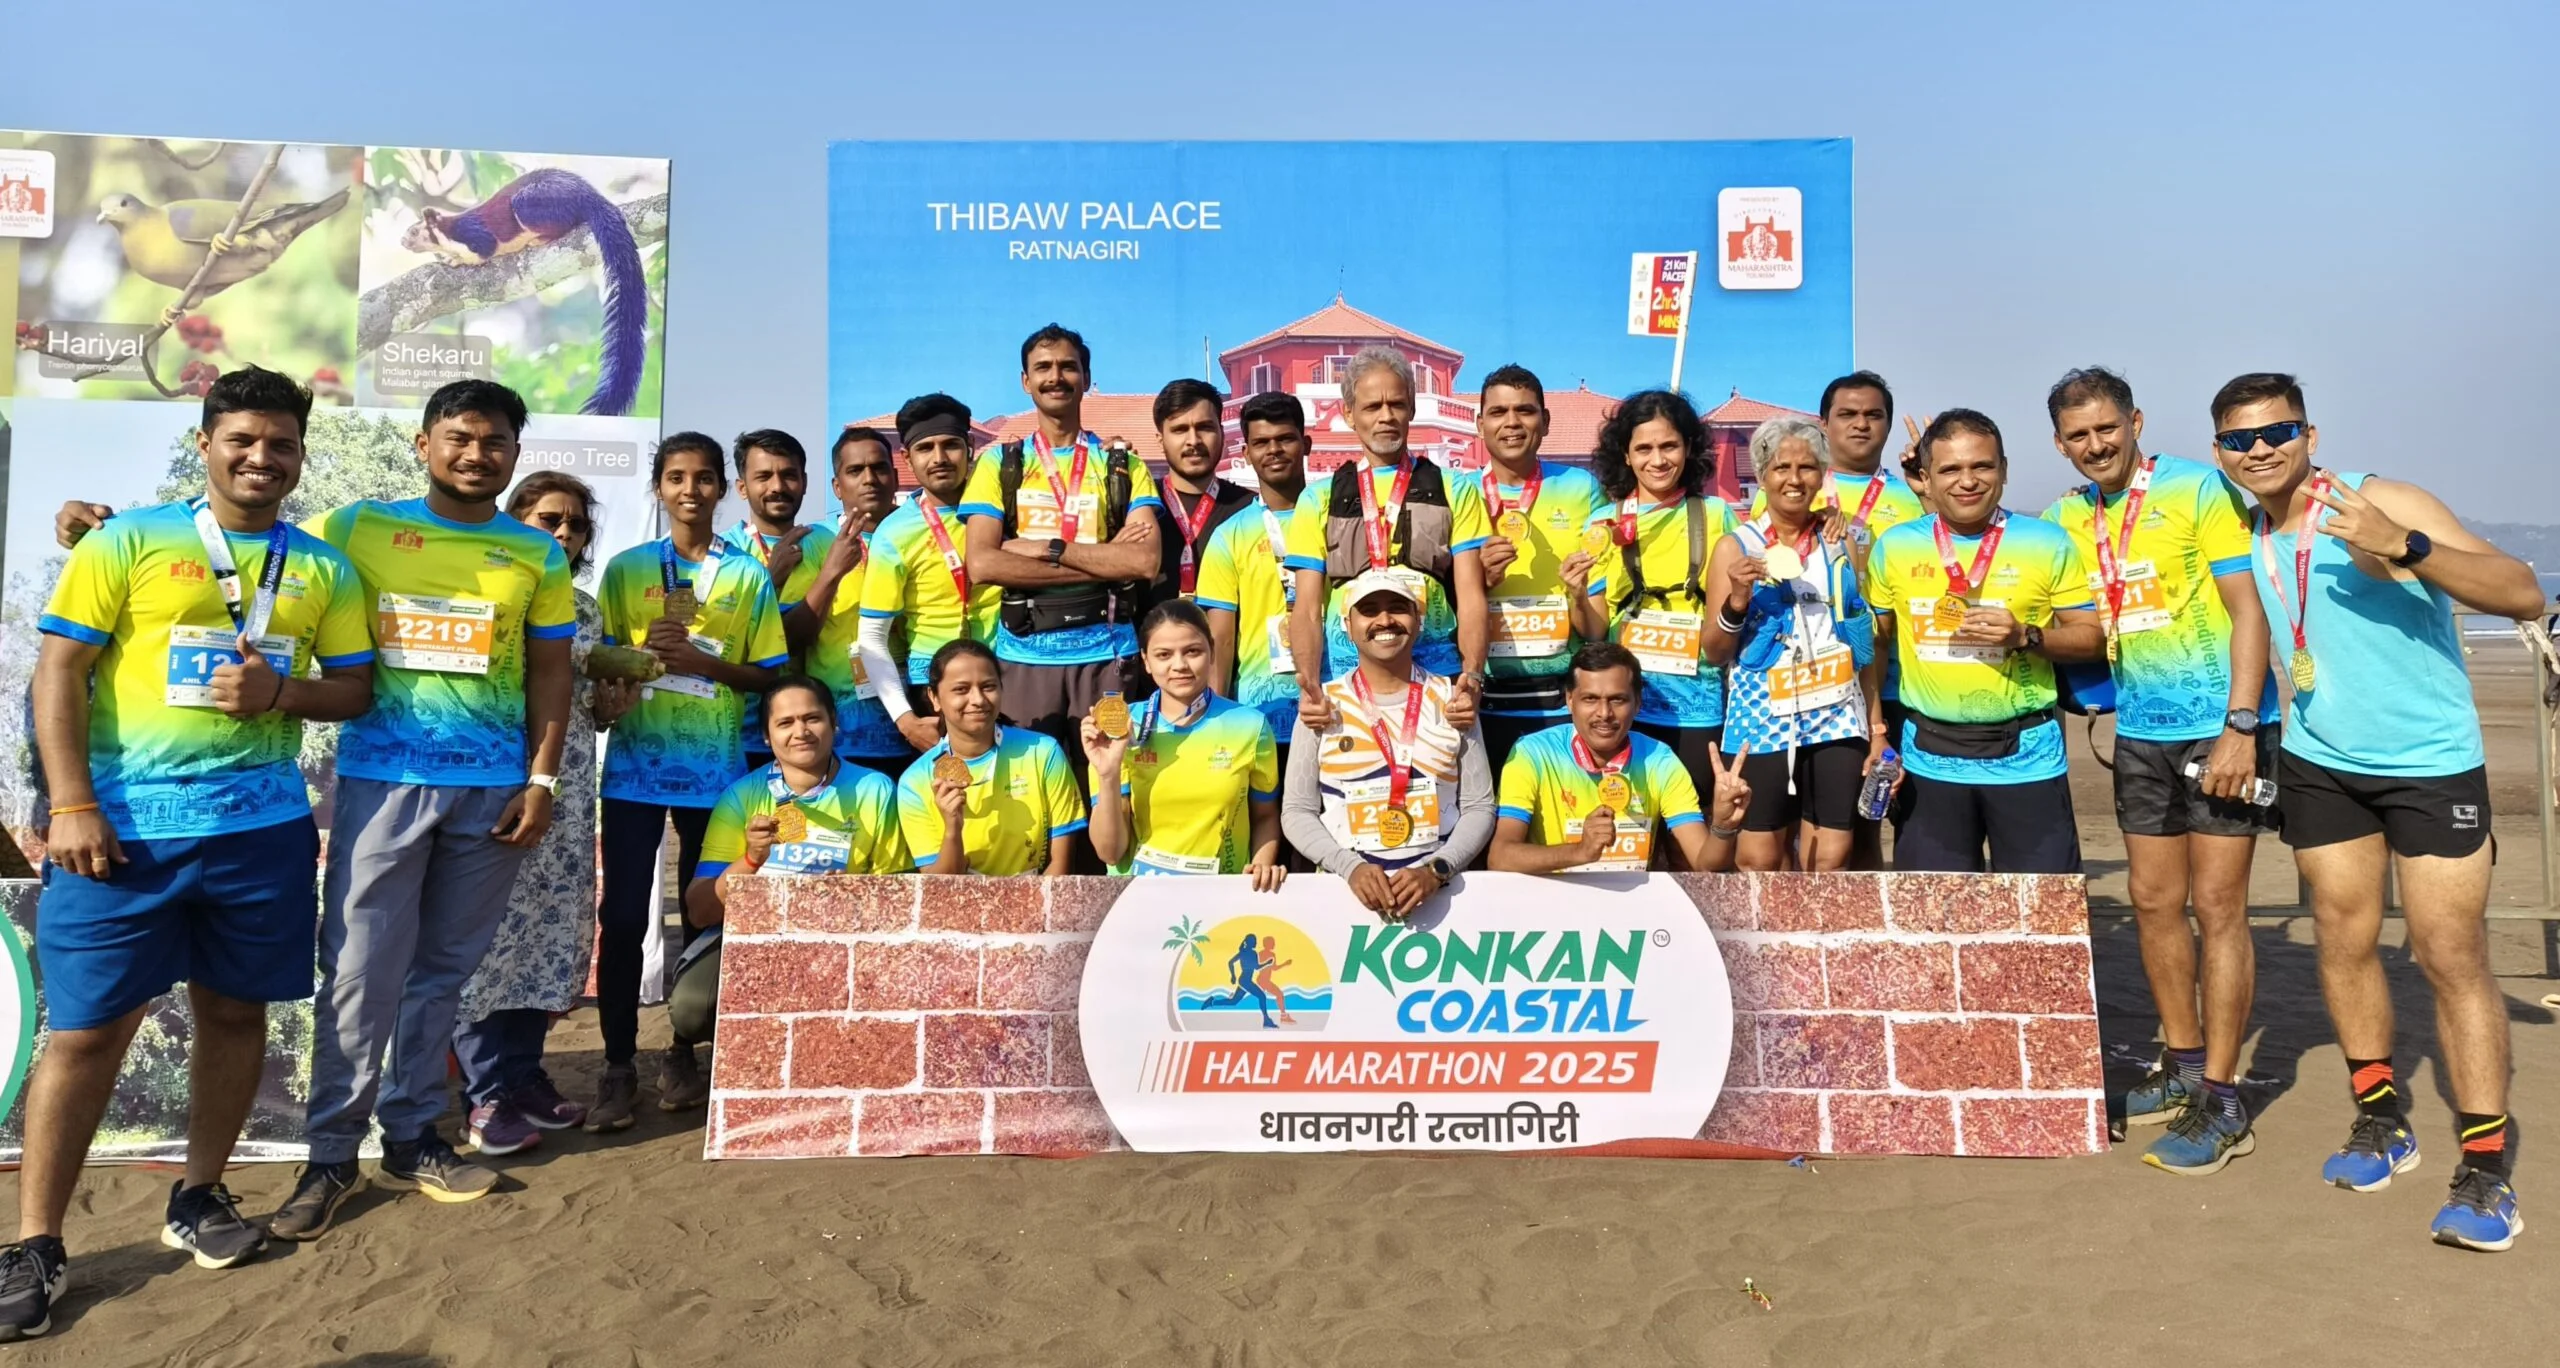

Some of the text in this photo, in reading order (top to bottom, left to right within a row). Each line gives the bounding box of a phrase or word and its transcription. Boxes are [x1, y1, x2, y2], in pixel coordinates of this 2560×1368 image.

[0, 214, 45, 223] HARASHTRA
[927, 201, 1222, 231] THIBAW PALACE
[1009, 240, 1140, 260] RATNAGIRI
[1663, 260, 1673, 270] 21
[1727, 264, 1793, 272] MAHARASHTRA
[47, 330, 145, 361] Hariyal
[382, 341, 484, 365] Shekaru
[381, 377, 420, 387] Malabar
[382, 366, 474, 379] Indian giant squirrel
[520, 447, 630, 469] ango Tree
[394, 617, 473, 644] 2219
[1500, 613, 1557, 633] 2284
[1630, 626, 1687, 650] 2275
[1781, 659, 1840, 690] 2277
[773, 842, 834, 867] 1326
[1602, 836, 1637, 854] 76
[1340, 925, 1647, 998] KONKAN
[1395, 988, 1650, 1034] COASTAL
[1202, 1051, 1640, 1086] HALF MARATHON 2025
[1259, 1101, 1581, 1143] धावनगरी रत्नागिरी
